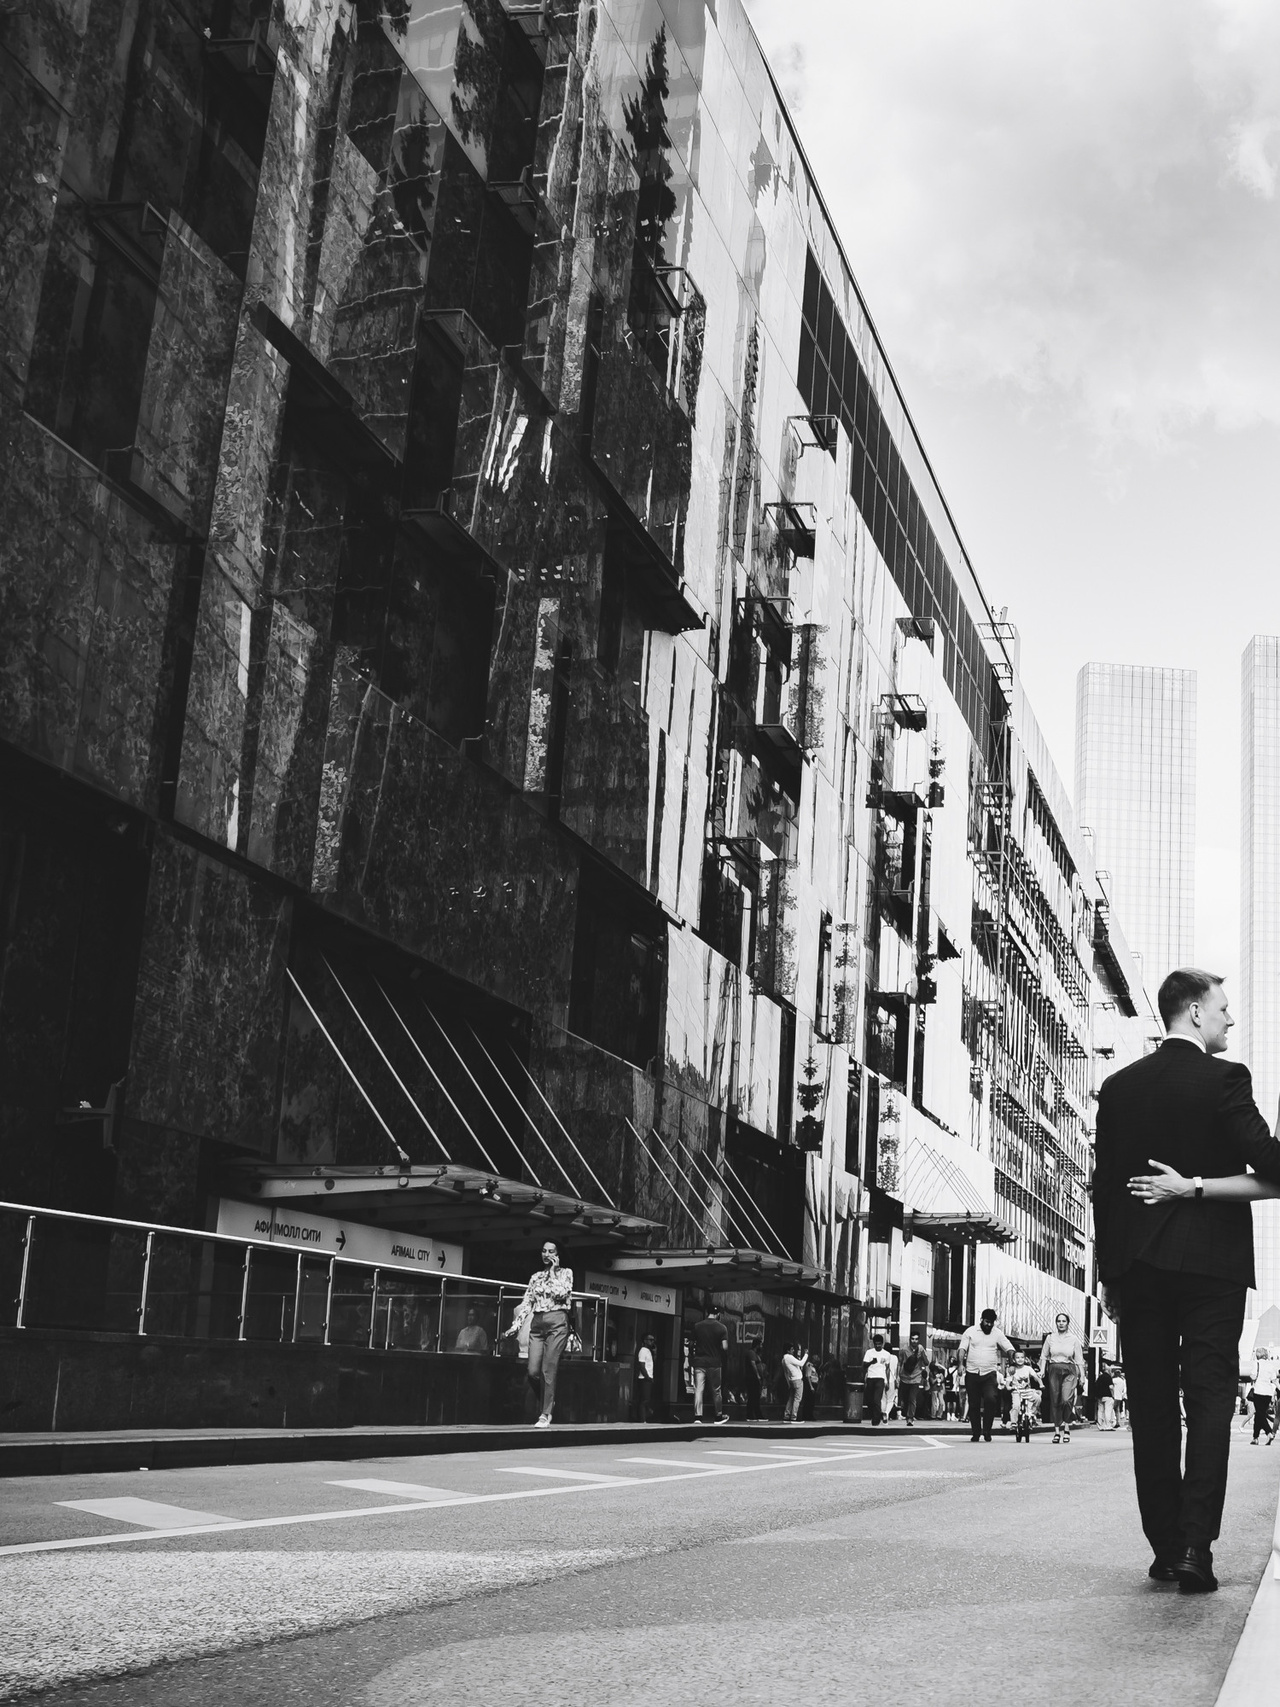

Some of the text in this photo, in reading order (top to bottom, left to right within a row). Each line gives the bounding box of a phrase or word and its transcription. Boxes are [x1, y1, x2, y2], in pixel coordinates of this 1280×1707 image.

[301, 1227, 321, 1243] СИТИ
[391, 1244, 431, 1262] AFIMALL CITY
